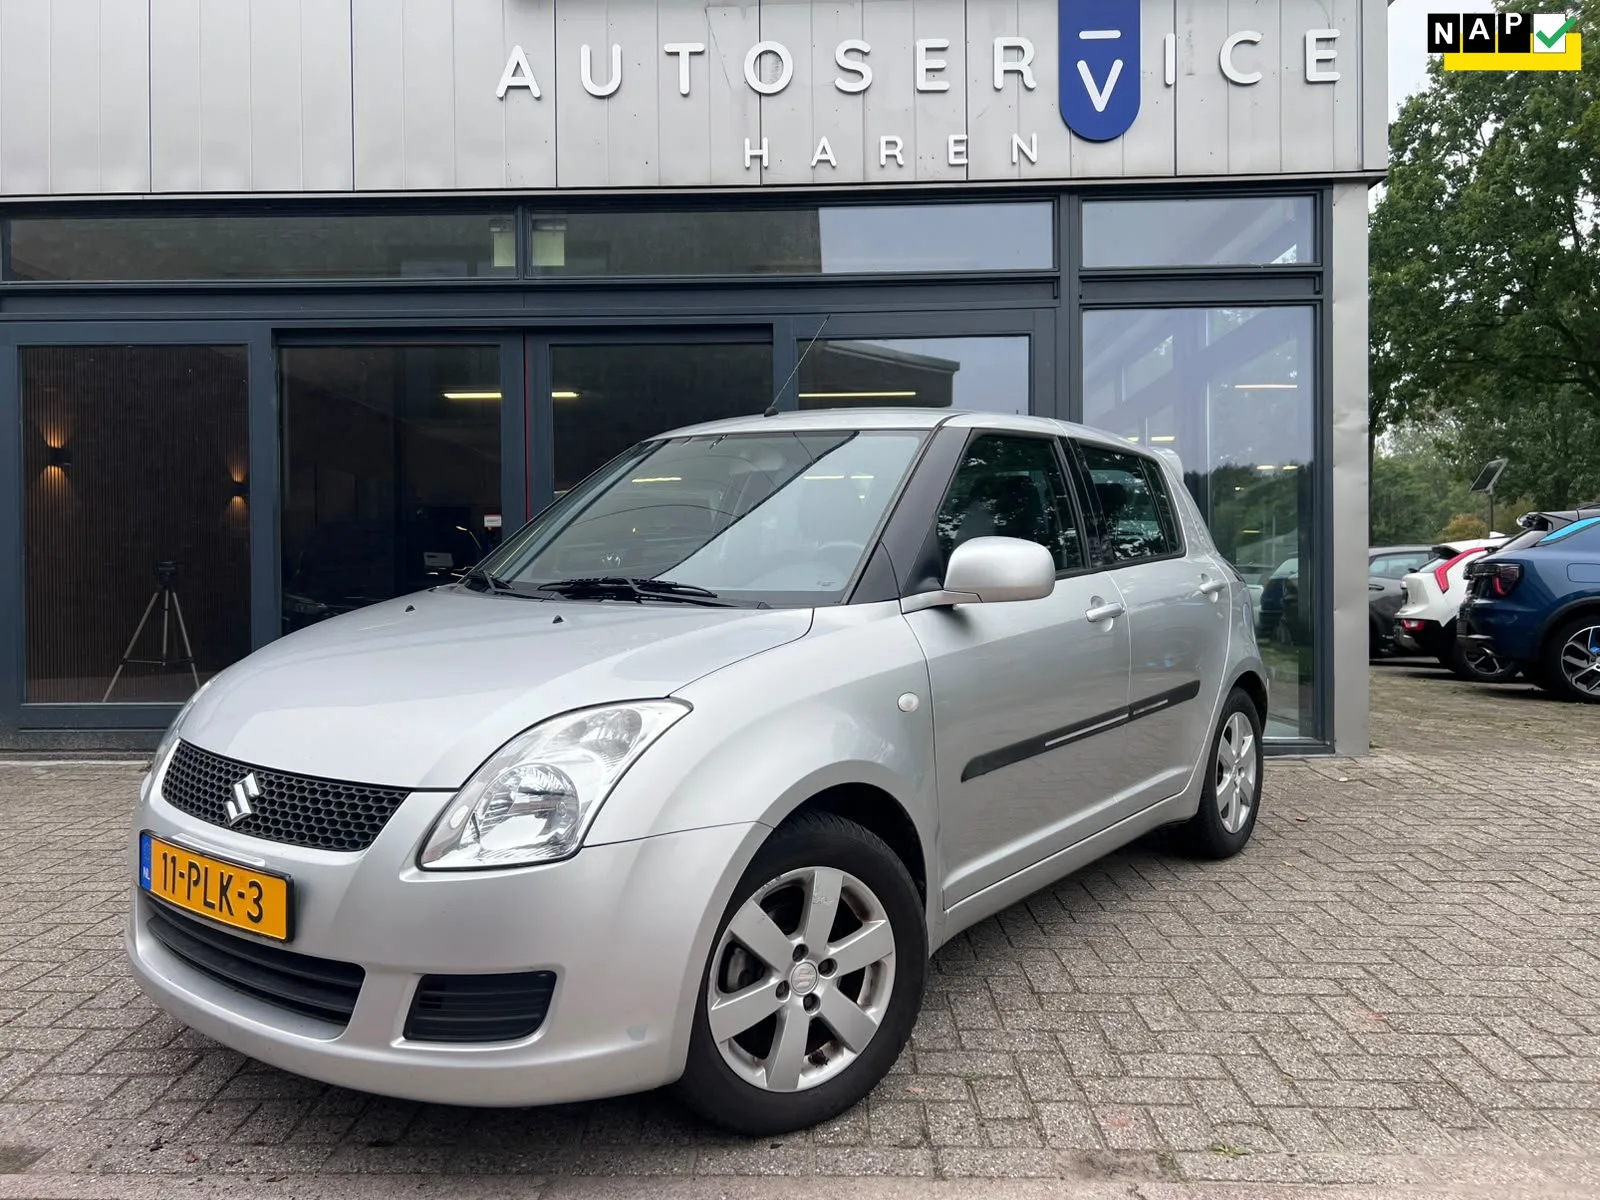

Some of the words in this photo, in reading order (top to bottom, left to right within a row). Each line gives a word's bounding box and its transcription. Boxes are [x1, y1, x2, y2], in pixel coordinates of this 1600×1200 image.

[496, 28, 1341, 112] AUTOSERVICE
[743, 132, 1038, 169] HAREN
[161, 851, 264, 924] 11-PLK-3
